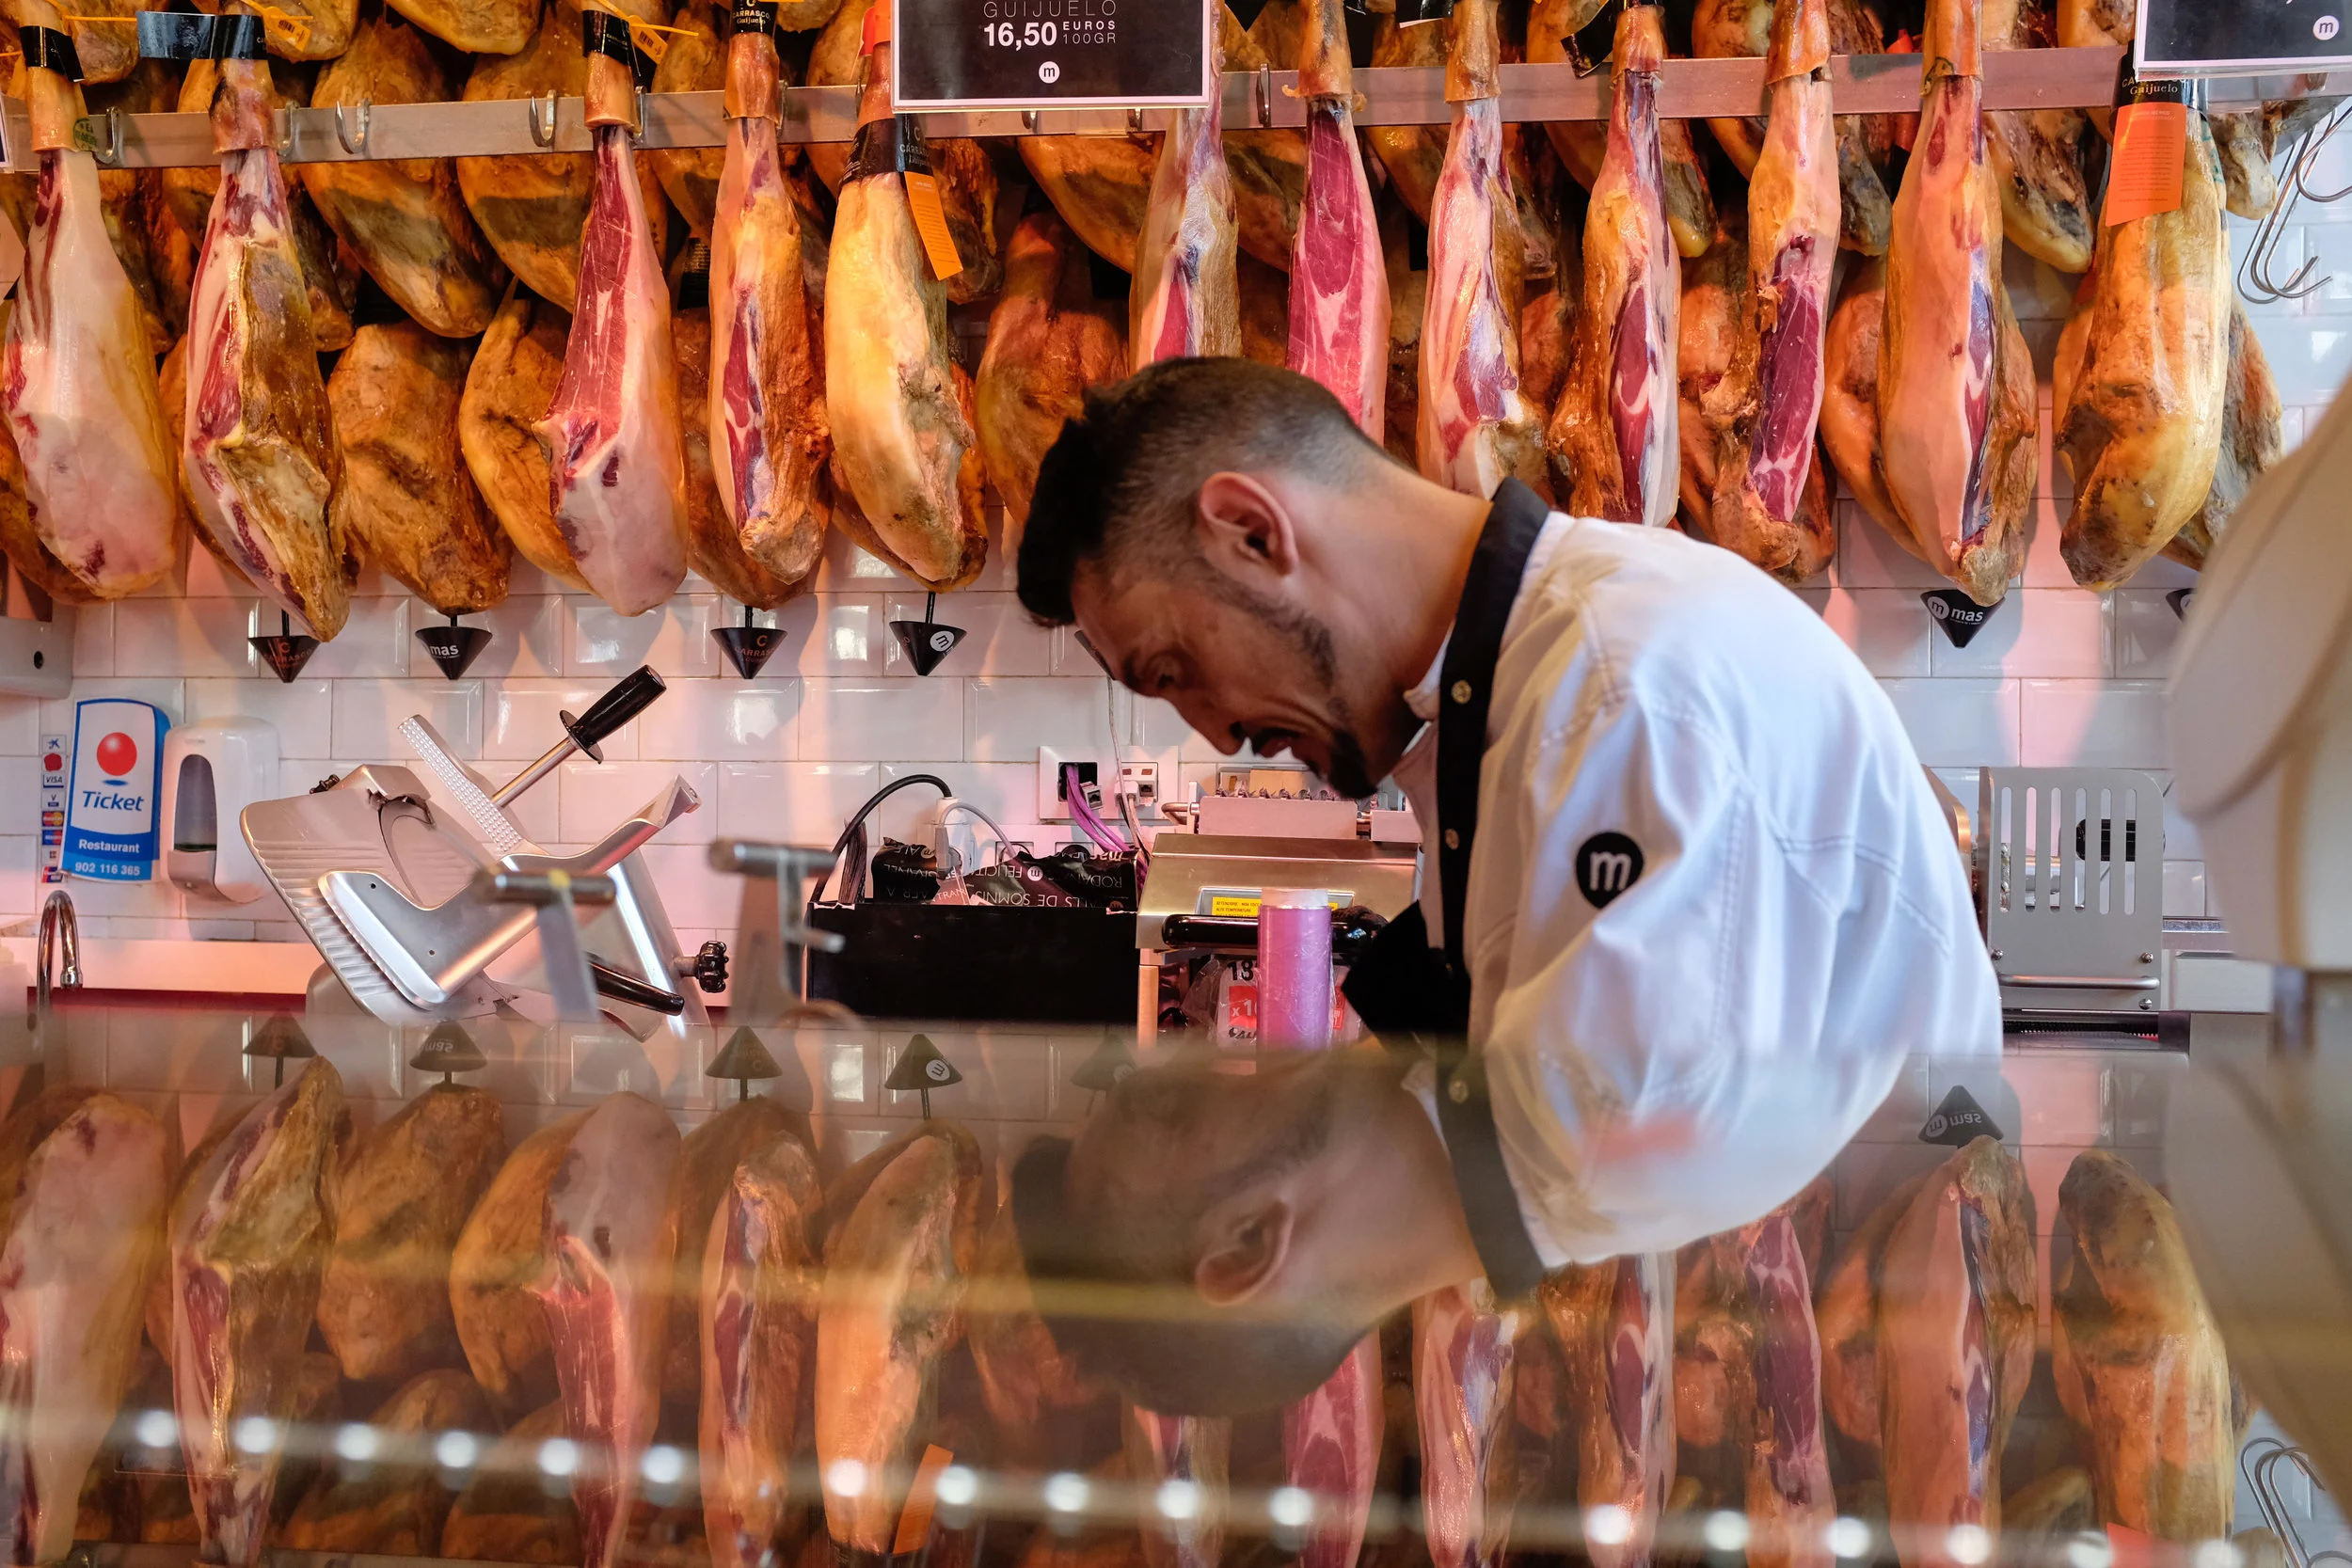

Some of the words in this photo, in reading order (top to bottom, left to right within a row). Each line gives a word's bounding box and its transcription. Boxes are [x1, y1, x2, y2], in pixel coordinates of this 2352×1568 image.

[983, 0, 1117, 18] GUIJUELO
[984, 22, 1057, 51] 16,50
[1063, 21, 1116, 30] EUROS
[1063, 33, 1116, 44] 100GR
[2130, 86, 2178, 95] Guijuelo
[1951, 609, 1984, 622] mas
[430, 645, 459, 657] mas
[83, 790, 145, 812] Ticket
[78, 839, 140, 854] Restaurant
[75, 862, 96, 873] 902
[100, 863, 118, 874] 116
[121, 865, 140, 876] 365
[1590, 850, 1632, 892] m
[1038, 895, 1057, 907] DE
